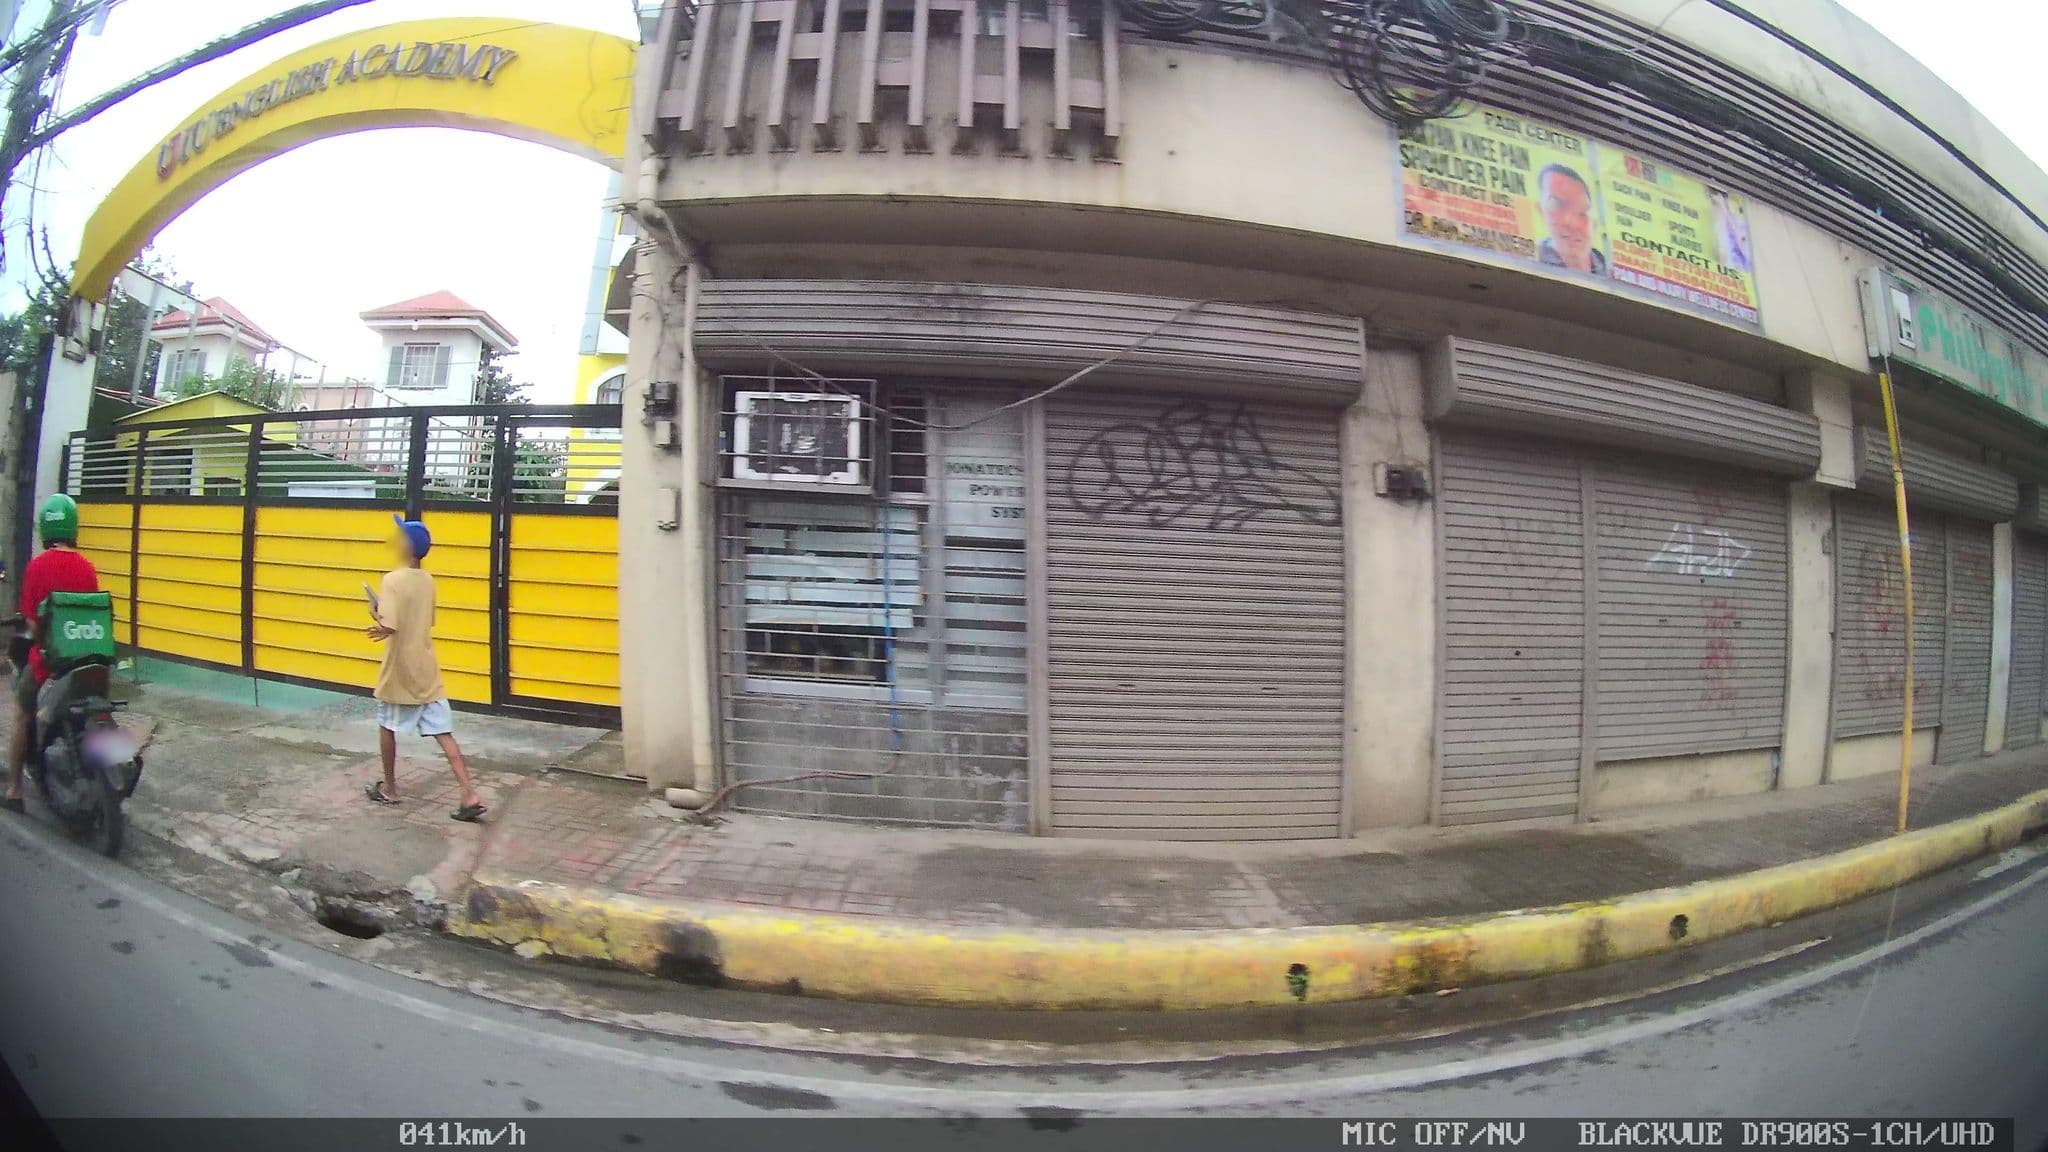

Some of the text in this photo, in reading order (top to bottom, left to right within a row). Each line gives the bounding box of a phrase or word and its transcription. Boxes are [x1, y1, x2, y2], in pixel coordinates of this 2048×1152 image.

[213, 57, 337, 137] ENGLISH
[334, 41, 519, 86] ACADEMY
[1400, 142, 1528, 197] SHOULDER PAIN
[1621, 231, 1712, 269] CONTACT
[63, 619, 105, 640] Grab
